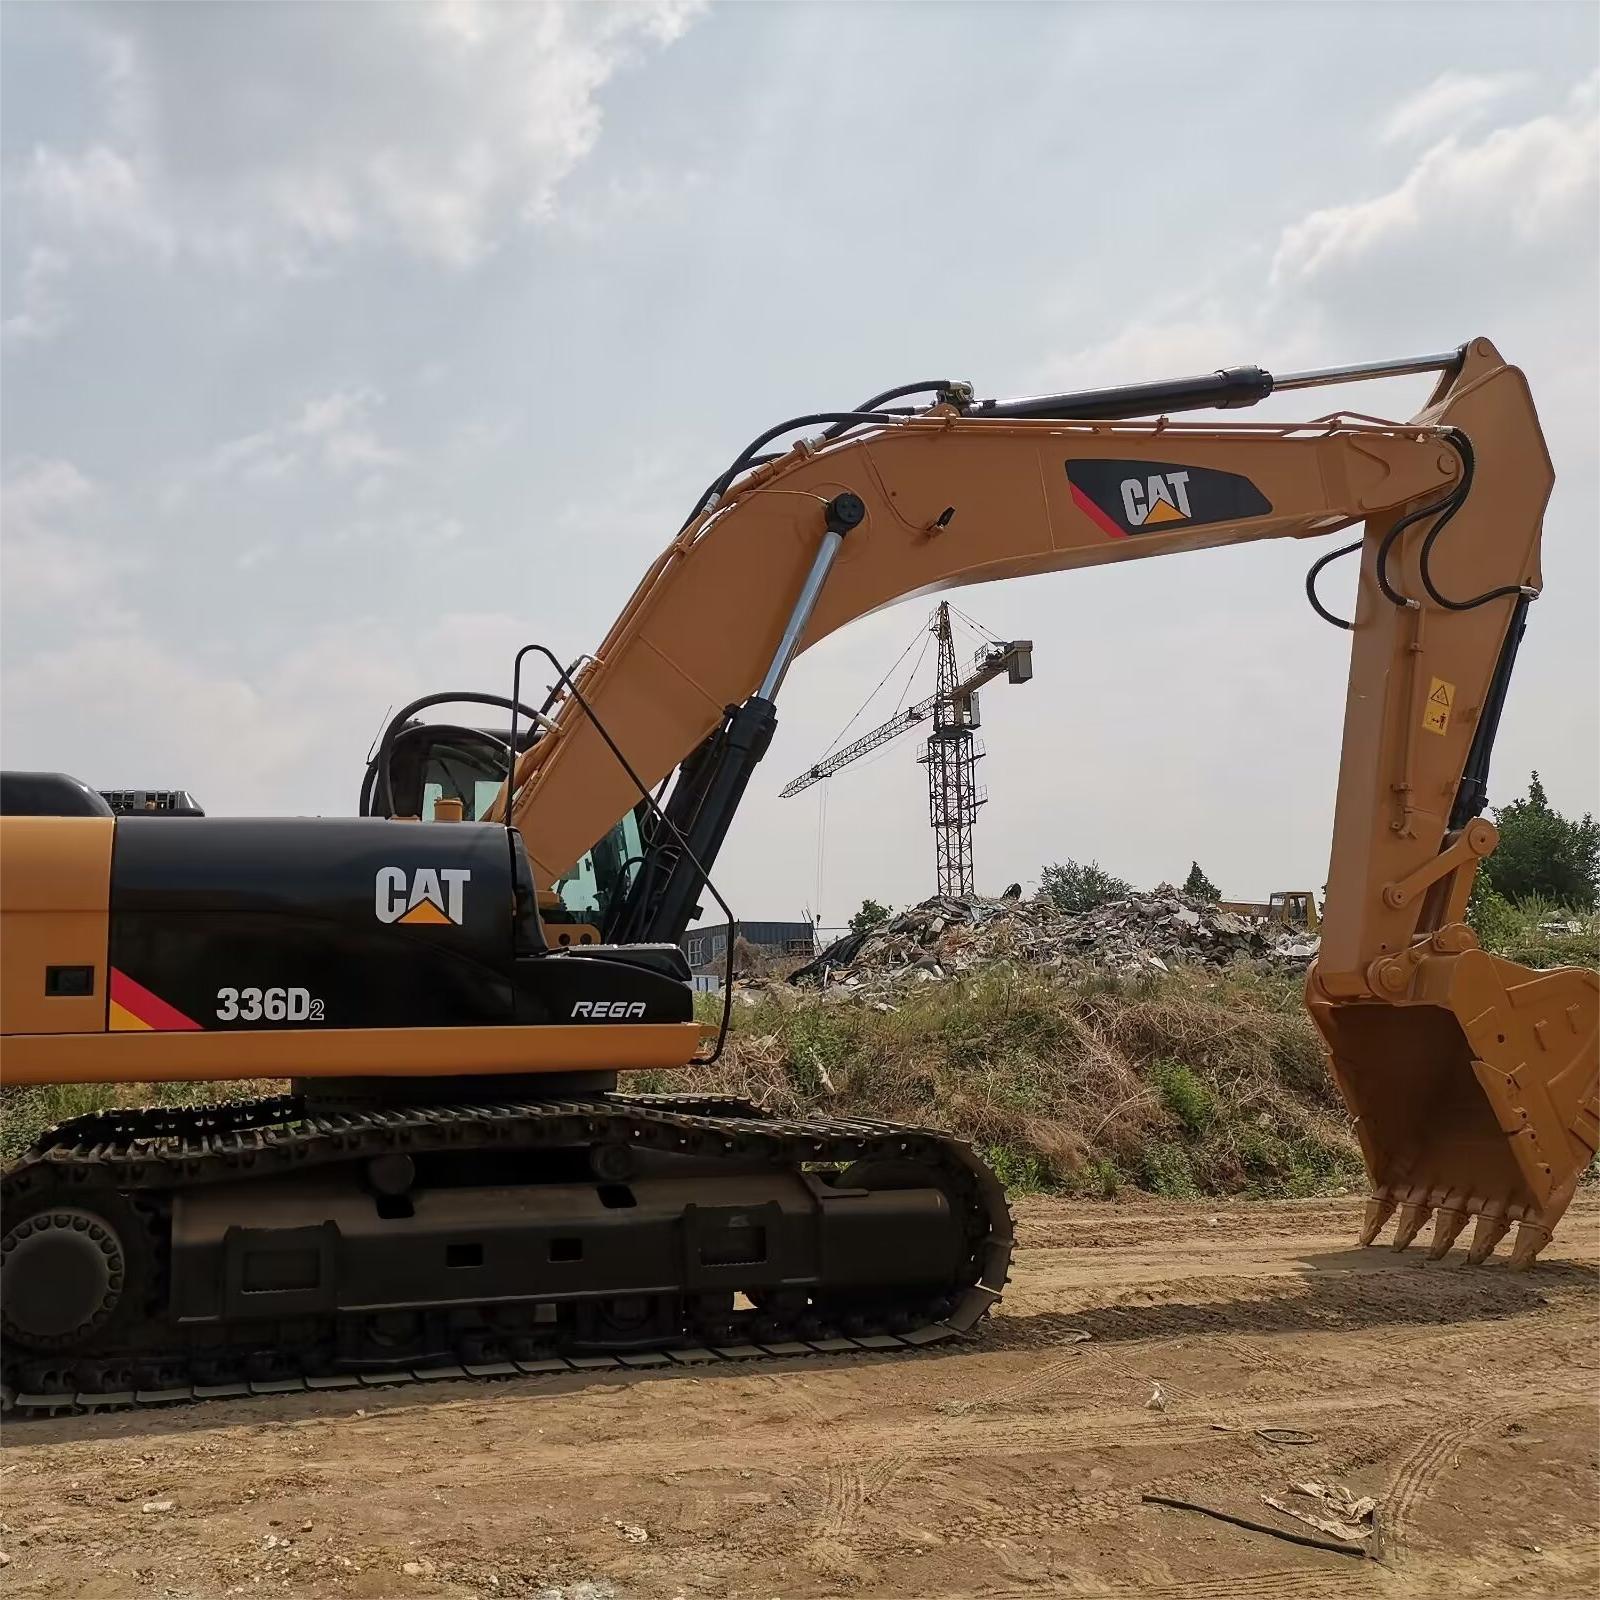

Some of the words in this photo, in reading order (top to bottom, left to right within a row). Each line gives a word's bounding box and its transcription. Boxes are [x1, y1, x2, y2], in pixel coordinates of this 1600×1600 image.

[1121, 471, 1192, 526] CAT
[375, 866, 471, 926] CAT
[216, 987, 325, 1021] 336D2
[570, 1001, 647, 1018] REGA
